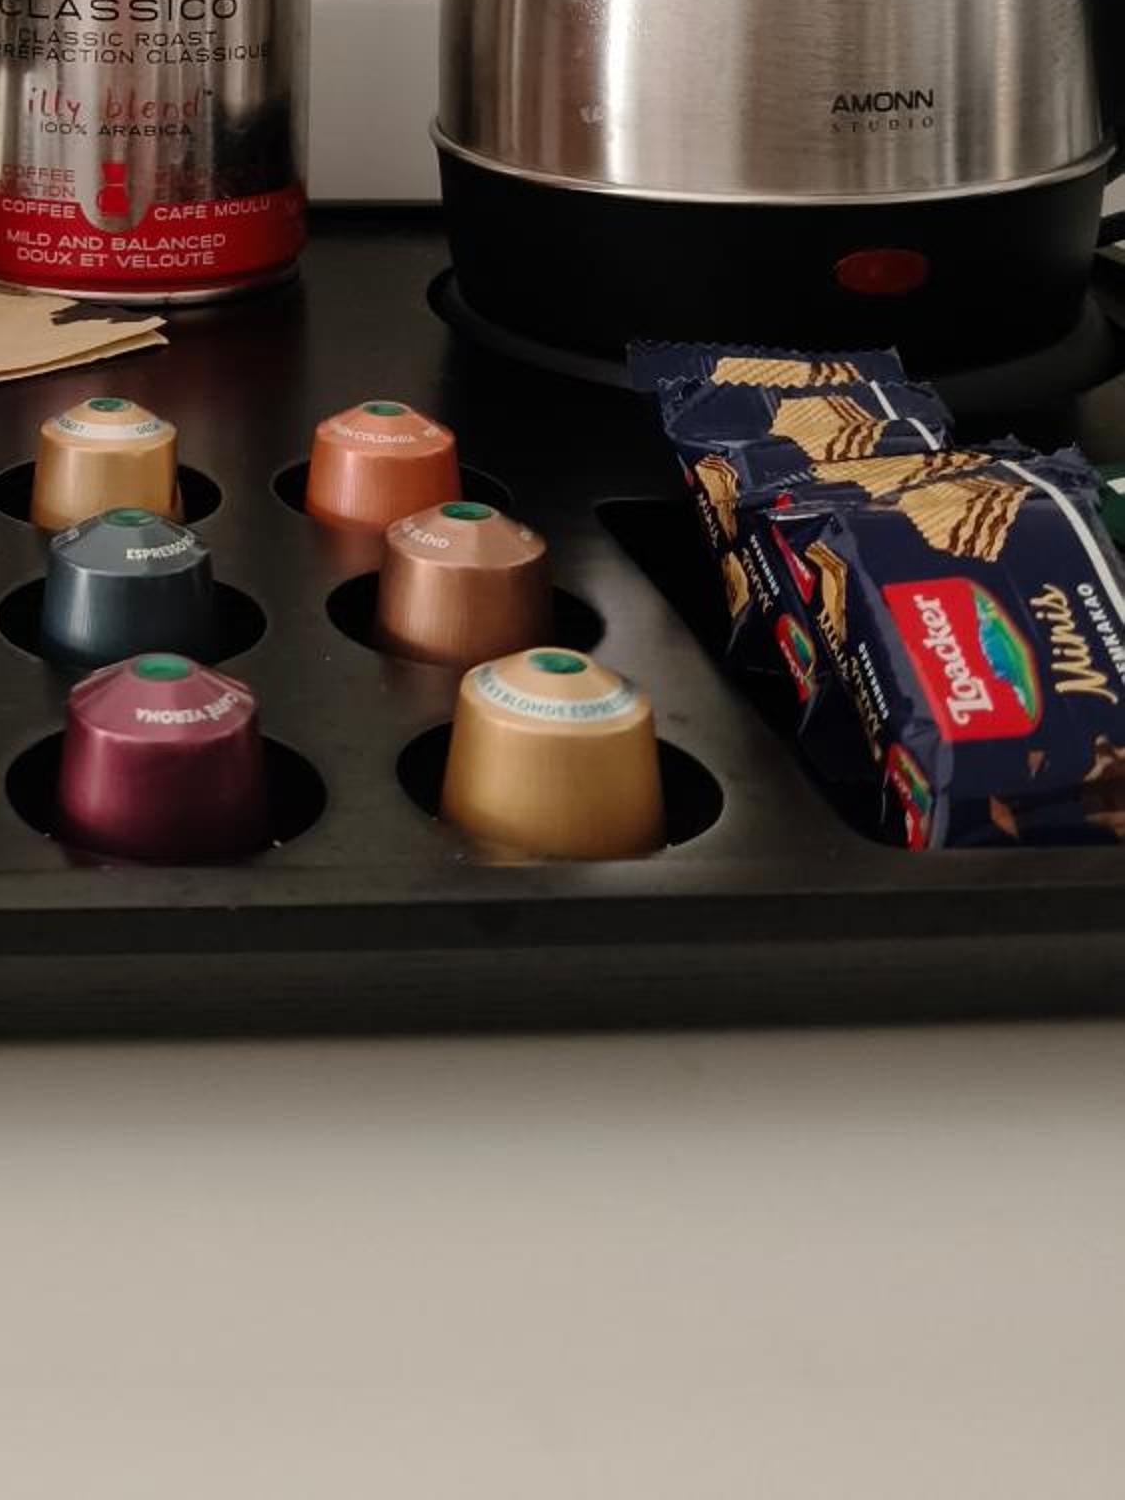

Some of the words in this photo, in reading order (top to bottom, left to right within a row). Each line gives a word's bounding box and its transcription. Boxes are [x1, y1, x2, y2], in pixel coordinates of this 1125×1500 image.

[18, 28, 124, 47] CLASSIC
[135, 31, 217, 47] ROAST
[146, 44, 268, 64] CLASSIQUE
[28, 87, 81, 124] illy
[105, 86, 201, 120] blend
[831, 88, 934, 114] AMONN
[40, 122, 87, 135] 100%
[98, 123, 192, 137] ARABICA
[2, 200, 76, 219] COFFEE
[5, 229, 51, 246] MILD
[58, 235, 104, 250] AND
[111, 233, 226, 251] BALANCED
[16, 247, 72, 265] DOUX
[80, 253, 109, 267] ET
[1030, 583, 1118, 704] Minis
[913, 594, 993, 725] Loacker
